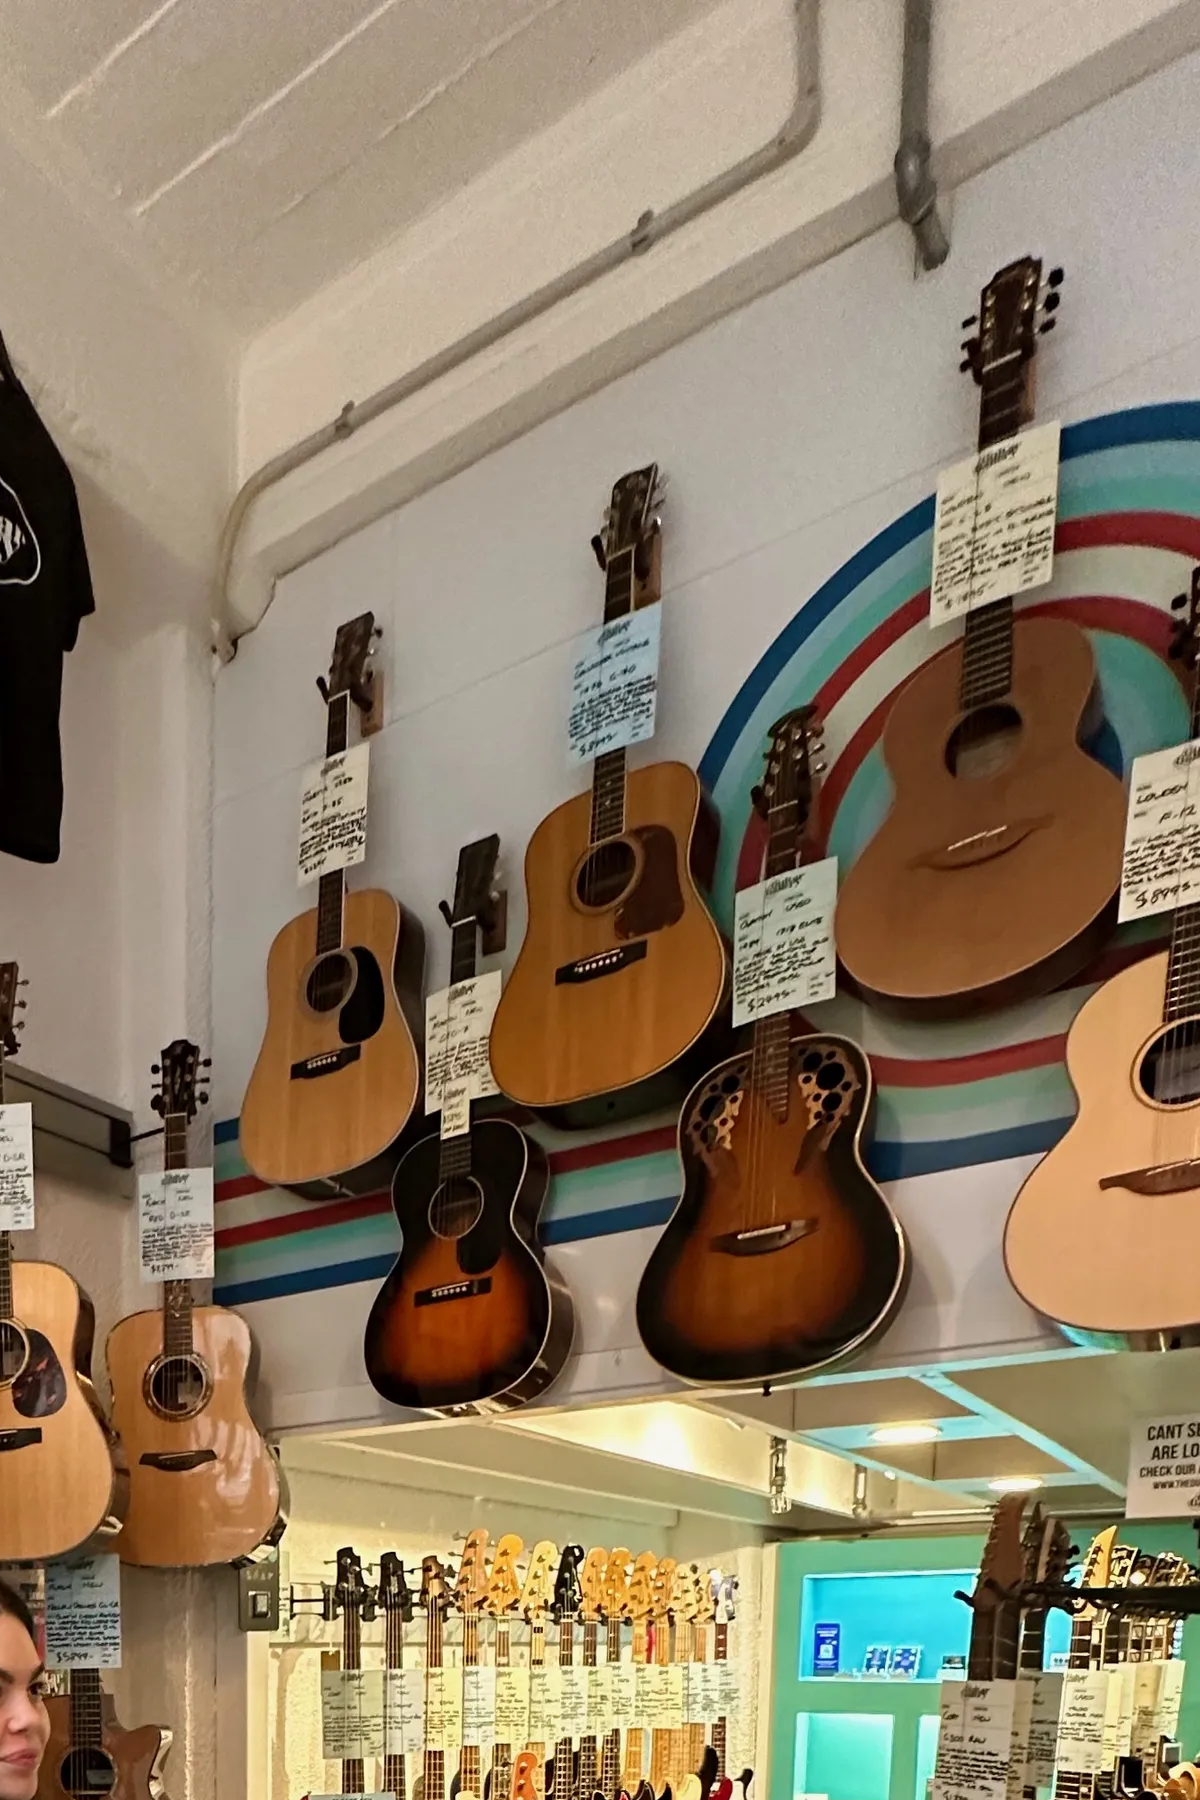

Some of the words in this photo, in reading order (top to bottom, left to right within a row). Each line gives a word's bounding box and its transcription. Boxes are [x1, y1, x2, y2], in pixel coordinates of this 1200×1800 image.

[1147, 1424, 1185, 1441] CANT
[1151, 1444, 1179, 1460] ARE
[1140, 1465, 1173, 1477] CHECK
[1175, 1464, 1196, 1476] OUR
